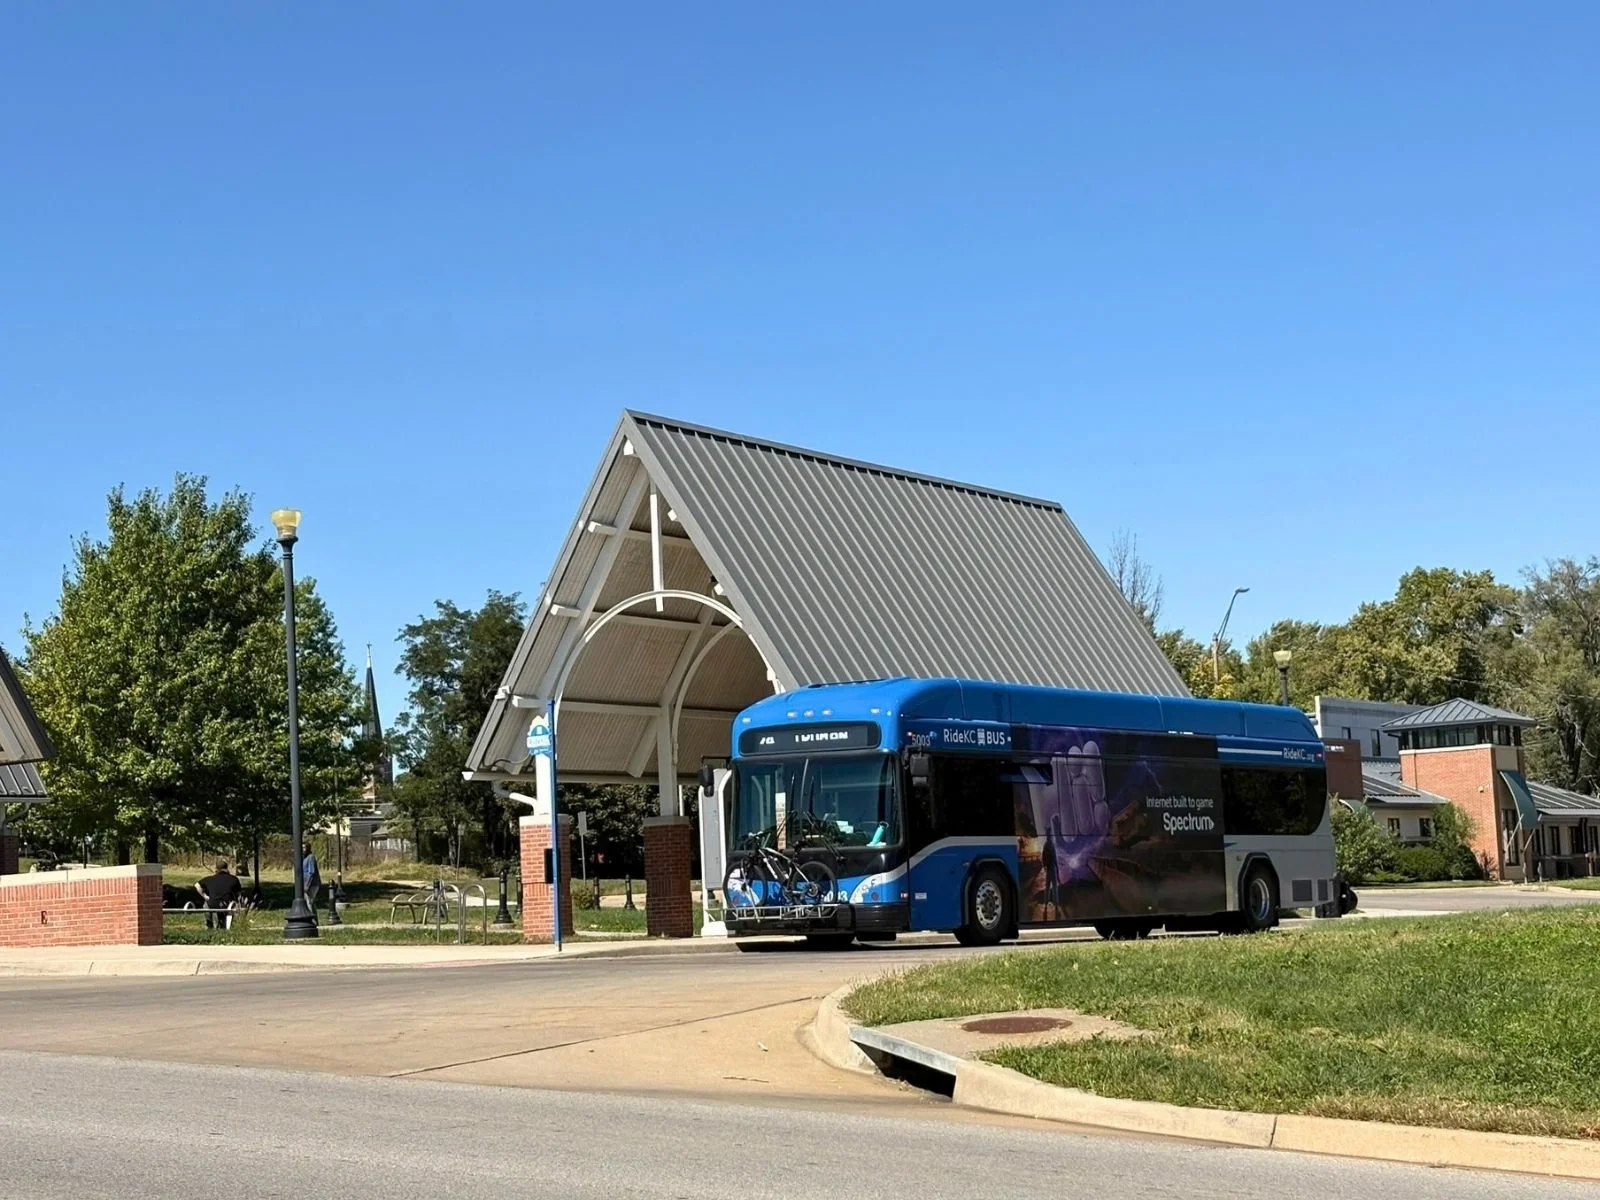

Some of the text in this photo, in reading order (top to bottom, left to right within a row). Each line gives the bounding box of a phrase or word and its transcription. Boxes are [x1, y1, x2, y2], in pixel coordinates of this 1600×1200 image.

[911, 734, 931, 747] 5003
[943, 728, 1006, 745] RideKC BUS
[1146, 795, 1214, 811] Internet built to game
[1163, 811, 1212, 836] Spectrum
